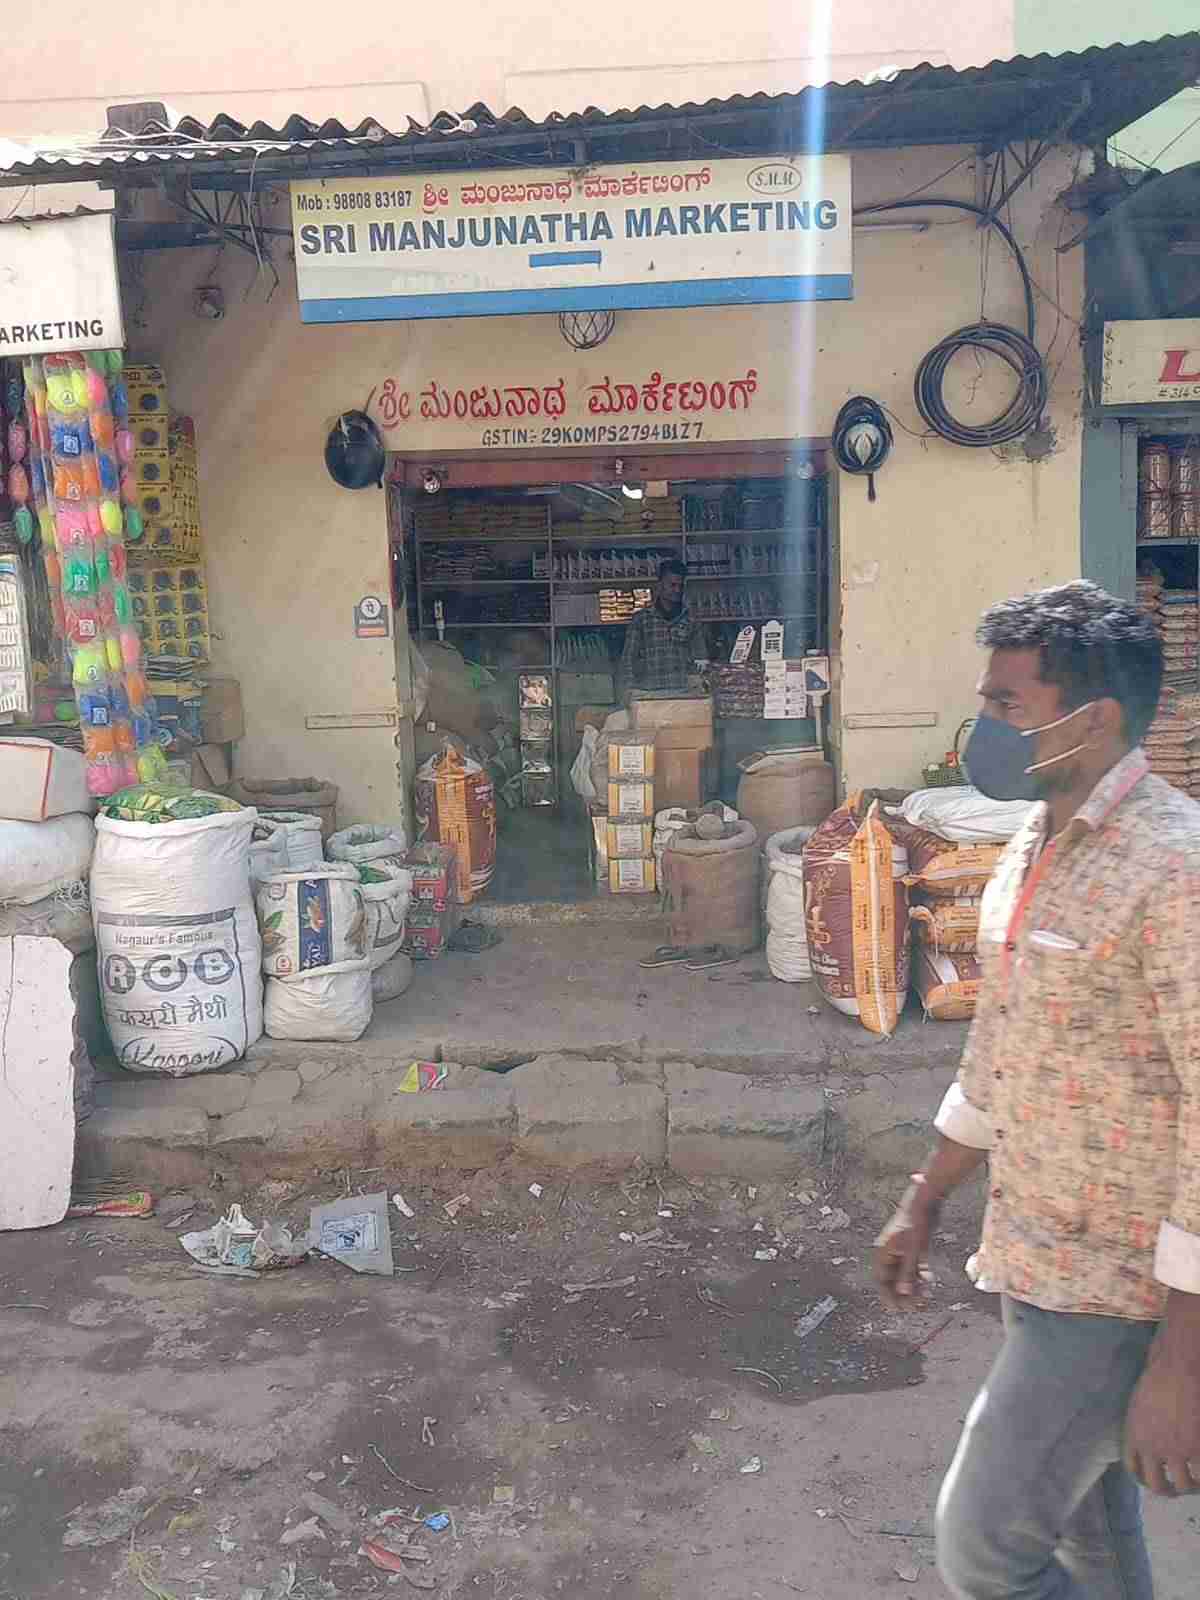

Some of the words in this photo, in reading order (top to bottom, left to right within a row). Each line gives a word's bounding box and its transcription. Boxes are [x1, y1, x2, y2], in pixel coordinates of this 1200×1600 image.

[334, 192, 371, 209] 98808
[375, 190, 411, 208] 83187
[423, 183, 449, 214] ಶ್ರೀ
[460, 179, 573, 204] ಮಂಜುನಾಥ
[300, 224, 356, 254] SRI
[369, 210, 613, 252] MANJUNATHA
[625, 200, 837, 238] MARKETING
[379, 379, 411, 429] ಶ್ರೀ
[420, 377, 567, 420] ಮಂಜುನಾಥ
[586, 369, 758, 413] ಮಾರ್ಕೆಟಿಂಗ್
